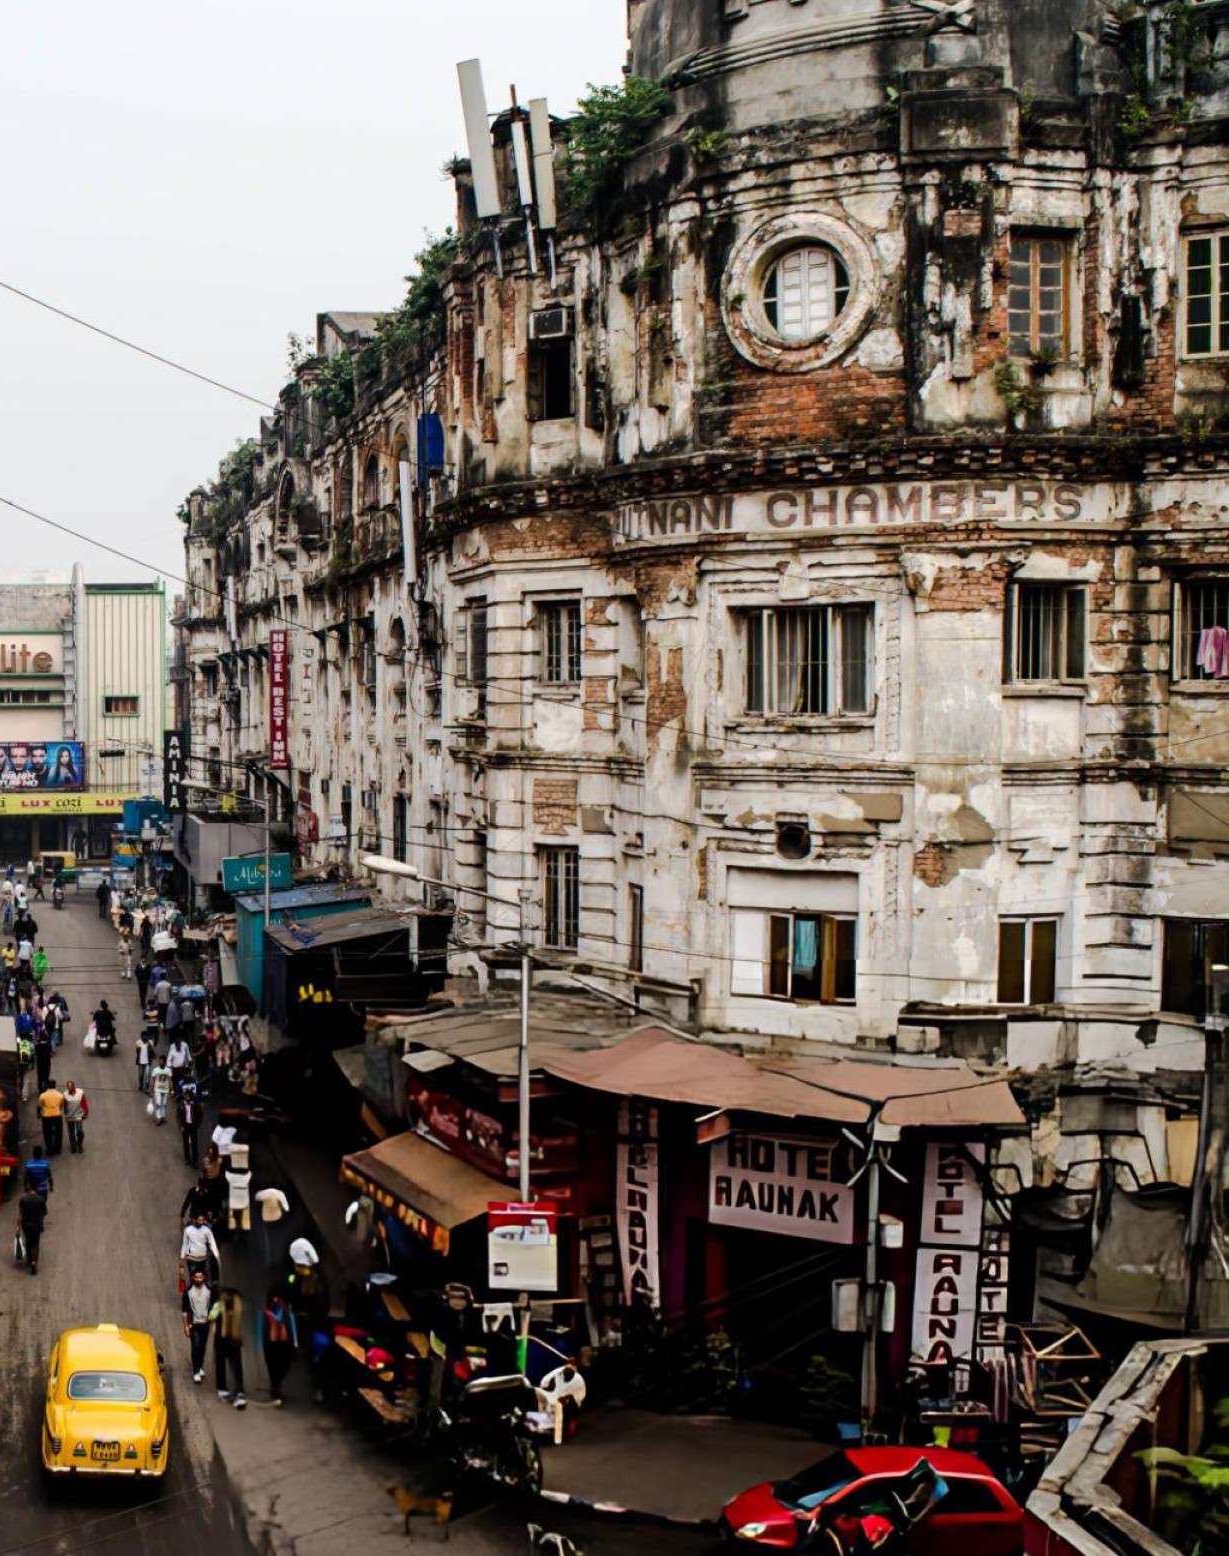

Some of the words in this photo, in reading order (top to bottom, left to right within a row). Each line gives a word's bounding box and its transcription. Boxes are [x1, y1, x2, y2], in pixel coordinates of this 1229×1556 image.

[766, 482, 1083, 530] CHAMBERS
[272, 632, 285, 683] HOTEL
[272, 731, 285, 761] INN
[168, 735, 182, 808] AMINIA
[20, 799, 52, 808] LUX
[715, 1174, 840, 1224] RAUNAK
